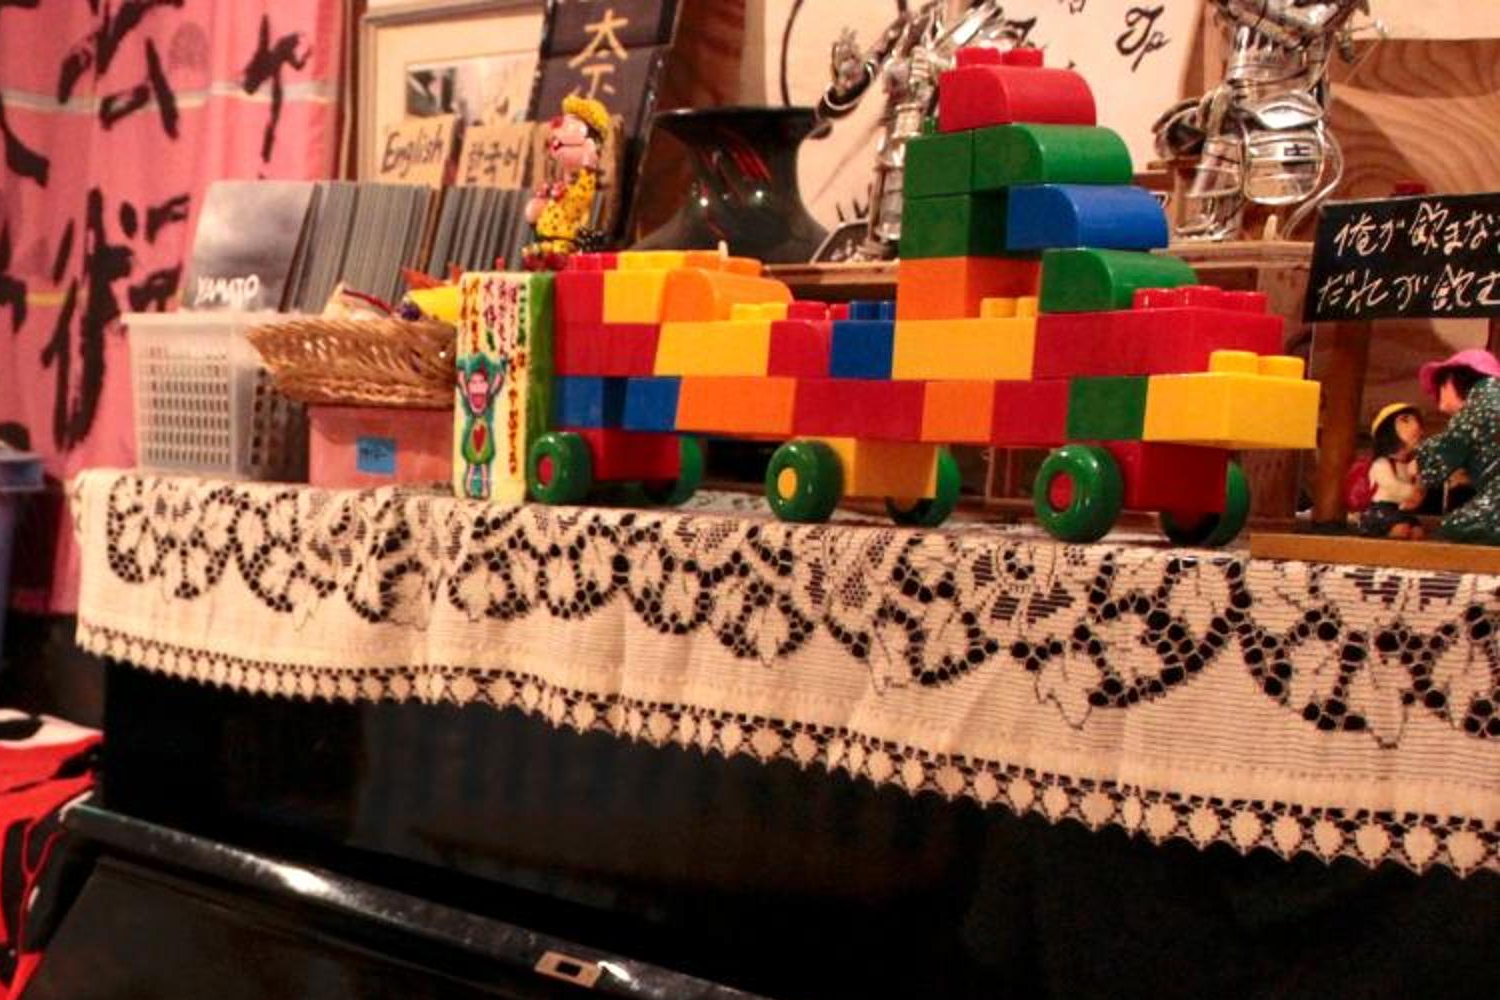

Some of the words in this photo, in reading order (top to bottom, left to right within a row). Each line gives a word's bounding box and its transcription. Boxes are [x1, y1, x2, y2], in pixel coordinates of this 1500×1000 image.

[381, 124, 443, 178] English
[1333, 202, 1500, 257] 俺が飲まな
